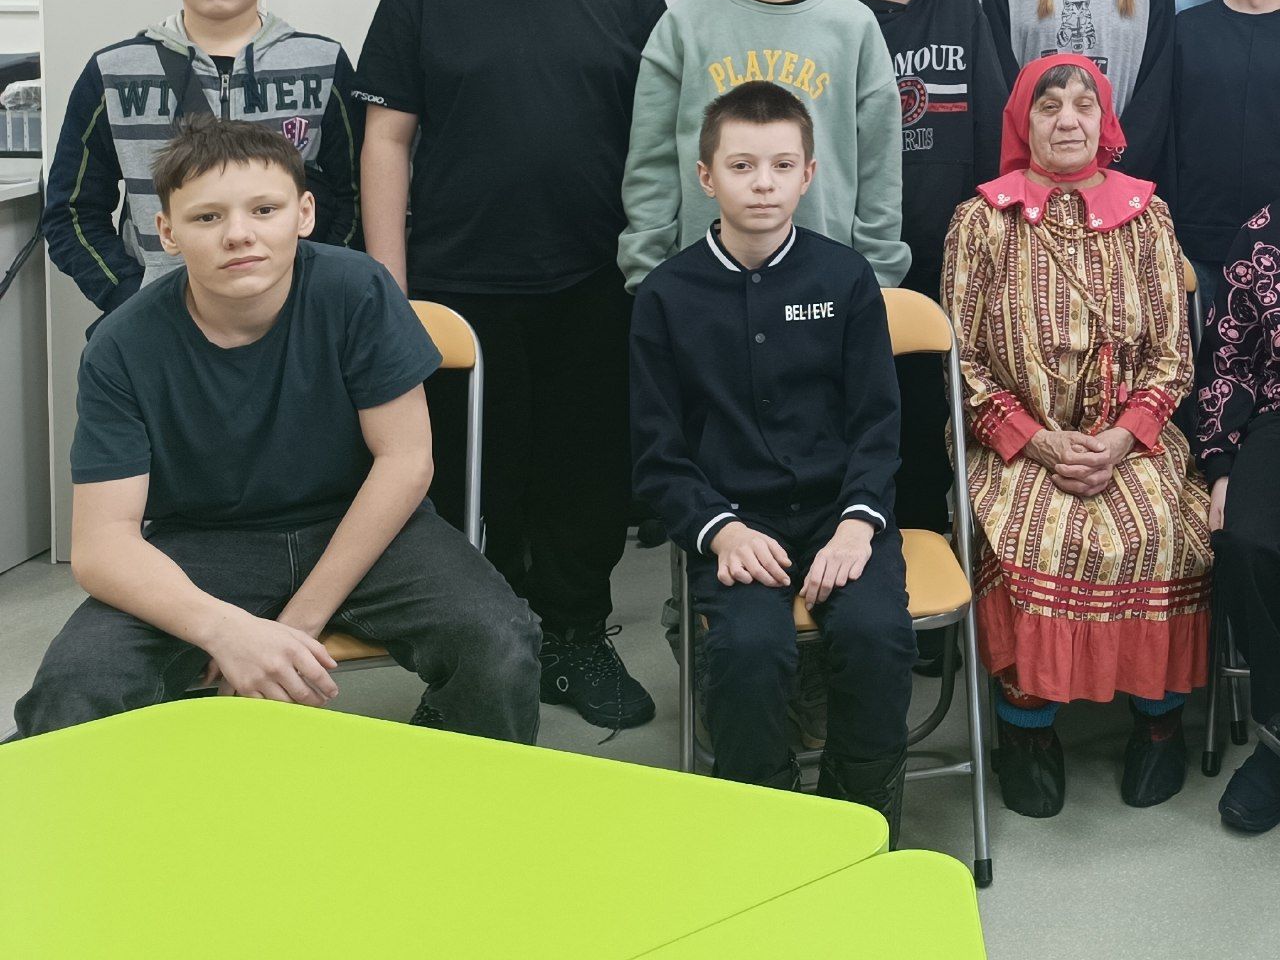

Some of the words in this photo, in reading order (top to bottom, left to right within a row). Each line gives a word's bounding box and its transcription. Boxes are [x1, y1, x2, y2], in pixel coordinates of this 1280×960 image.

[707, 48, 831, 100] PLAYERS
[894, 44, 967, 77] MOUR
[116, 73, 323, 117] WINER
[902, 127, 934, 152] RIS
[784, 300, 835, 322] BELIEVE
